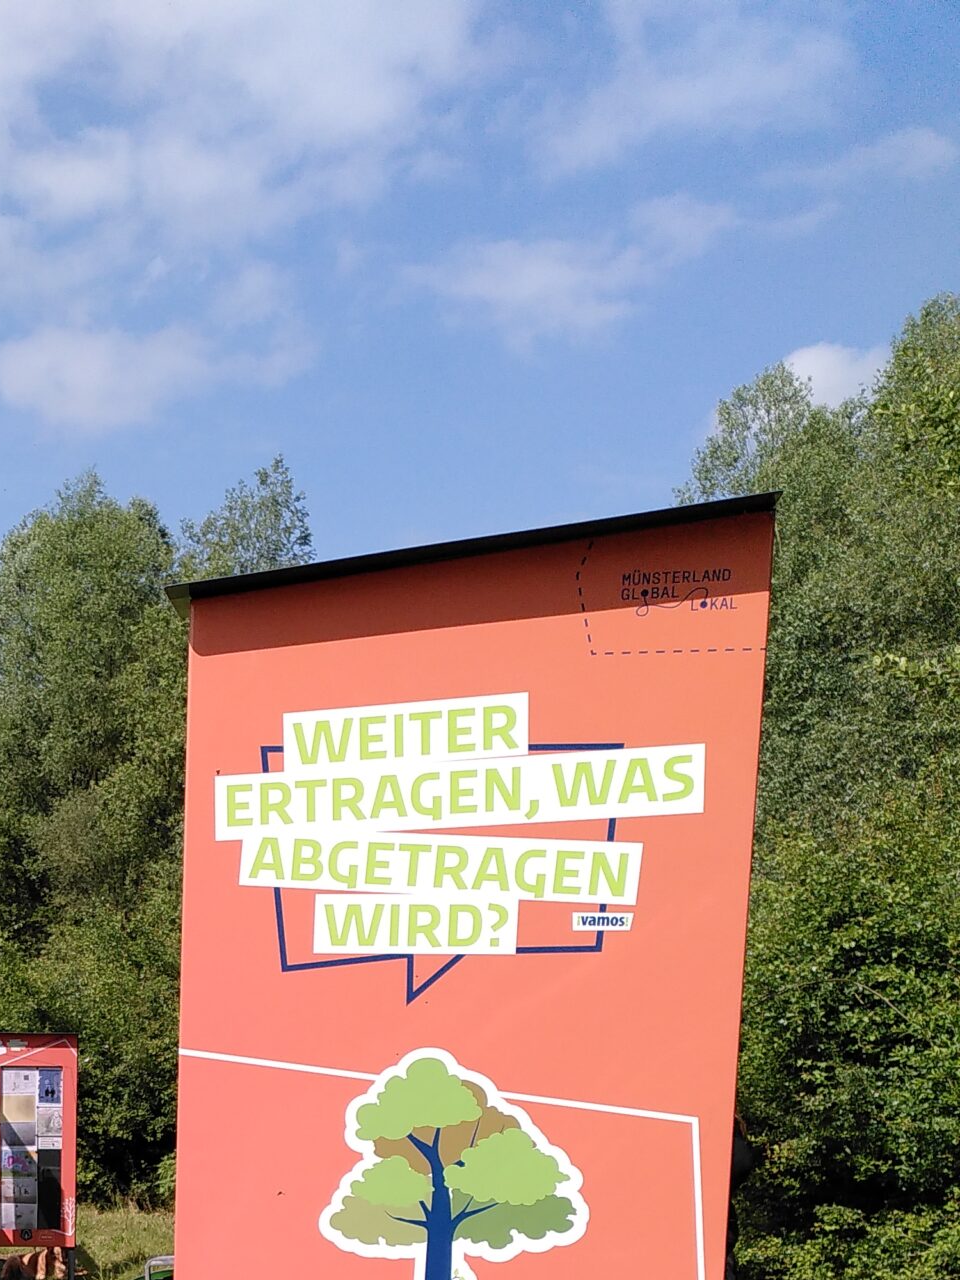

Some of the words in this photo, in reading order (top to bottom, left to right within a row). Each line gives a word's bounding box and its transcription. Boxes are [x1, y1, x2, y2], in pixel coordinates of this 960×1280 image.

[621, 587, 680, 601] GLOBAL
[622, 569, 731, 586] MÜNSTERLAND
[293, 704, 519, 766] WEITER
[225, 767, 540, 828] ERTRAGEN,
[551, 754, 696, 808] WAS
[248, 836, 630, 898] ABGETRAGEN
[324, 902, 510, 948] WIRD?
